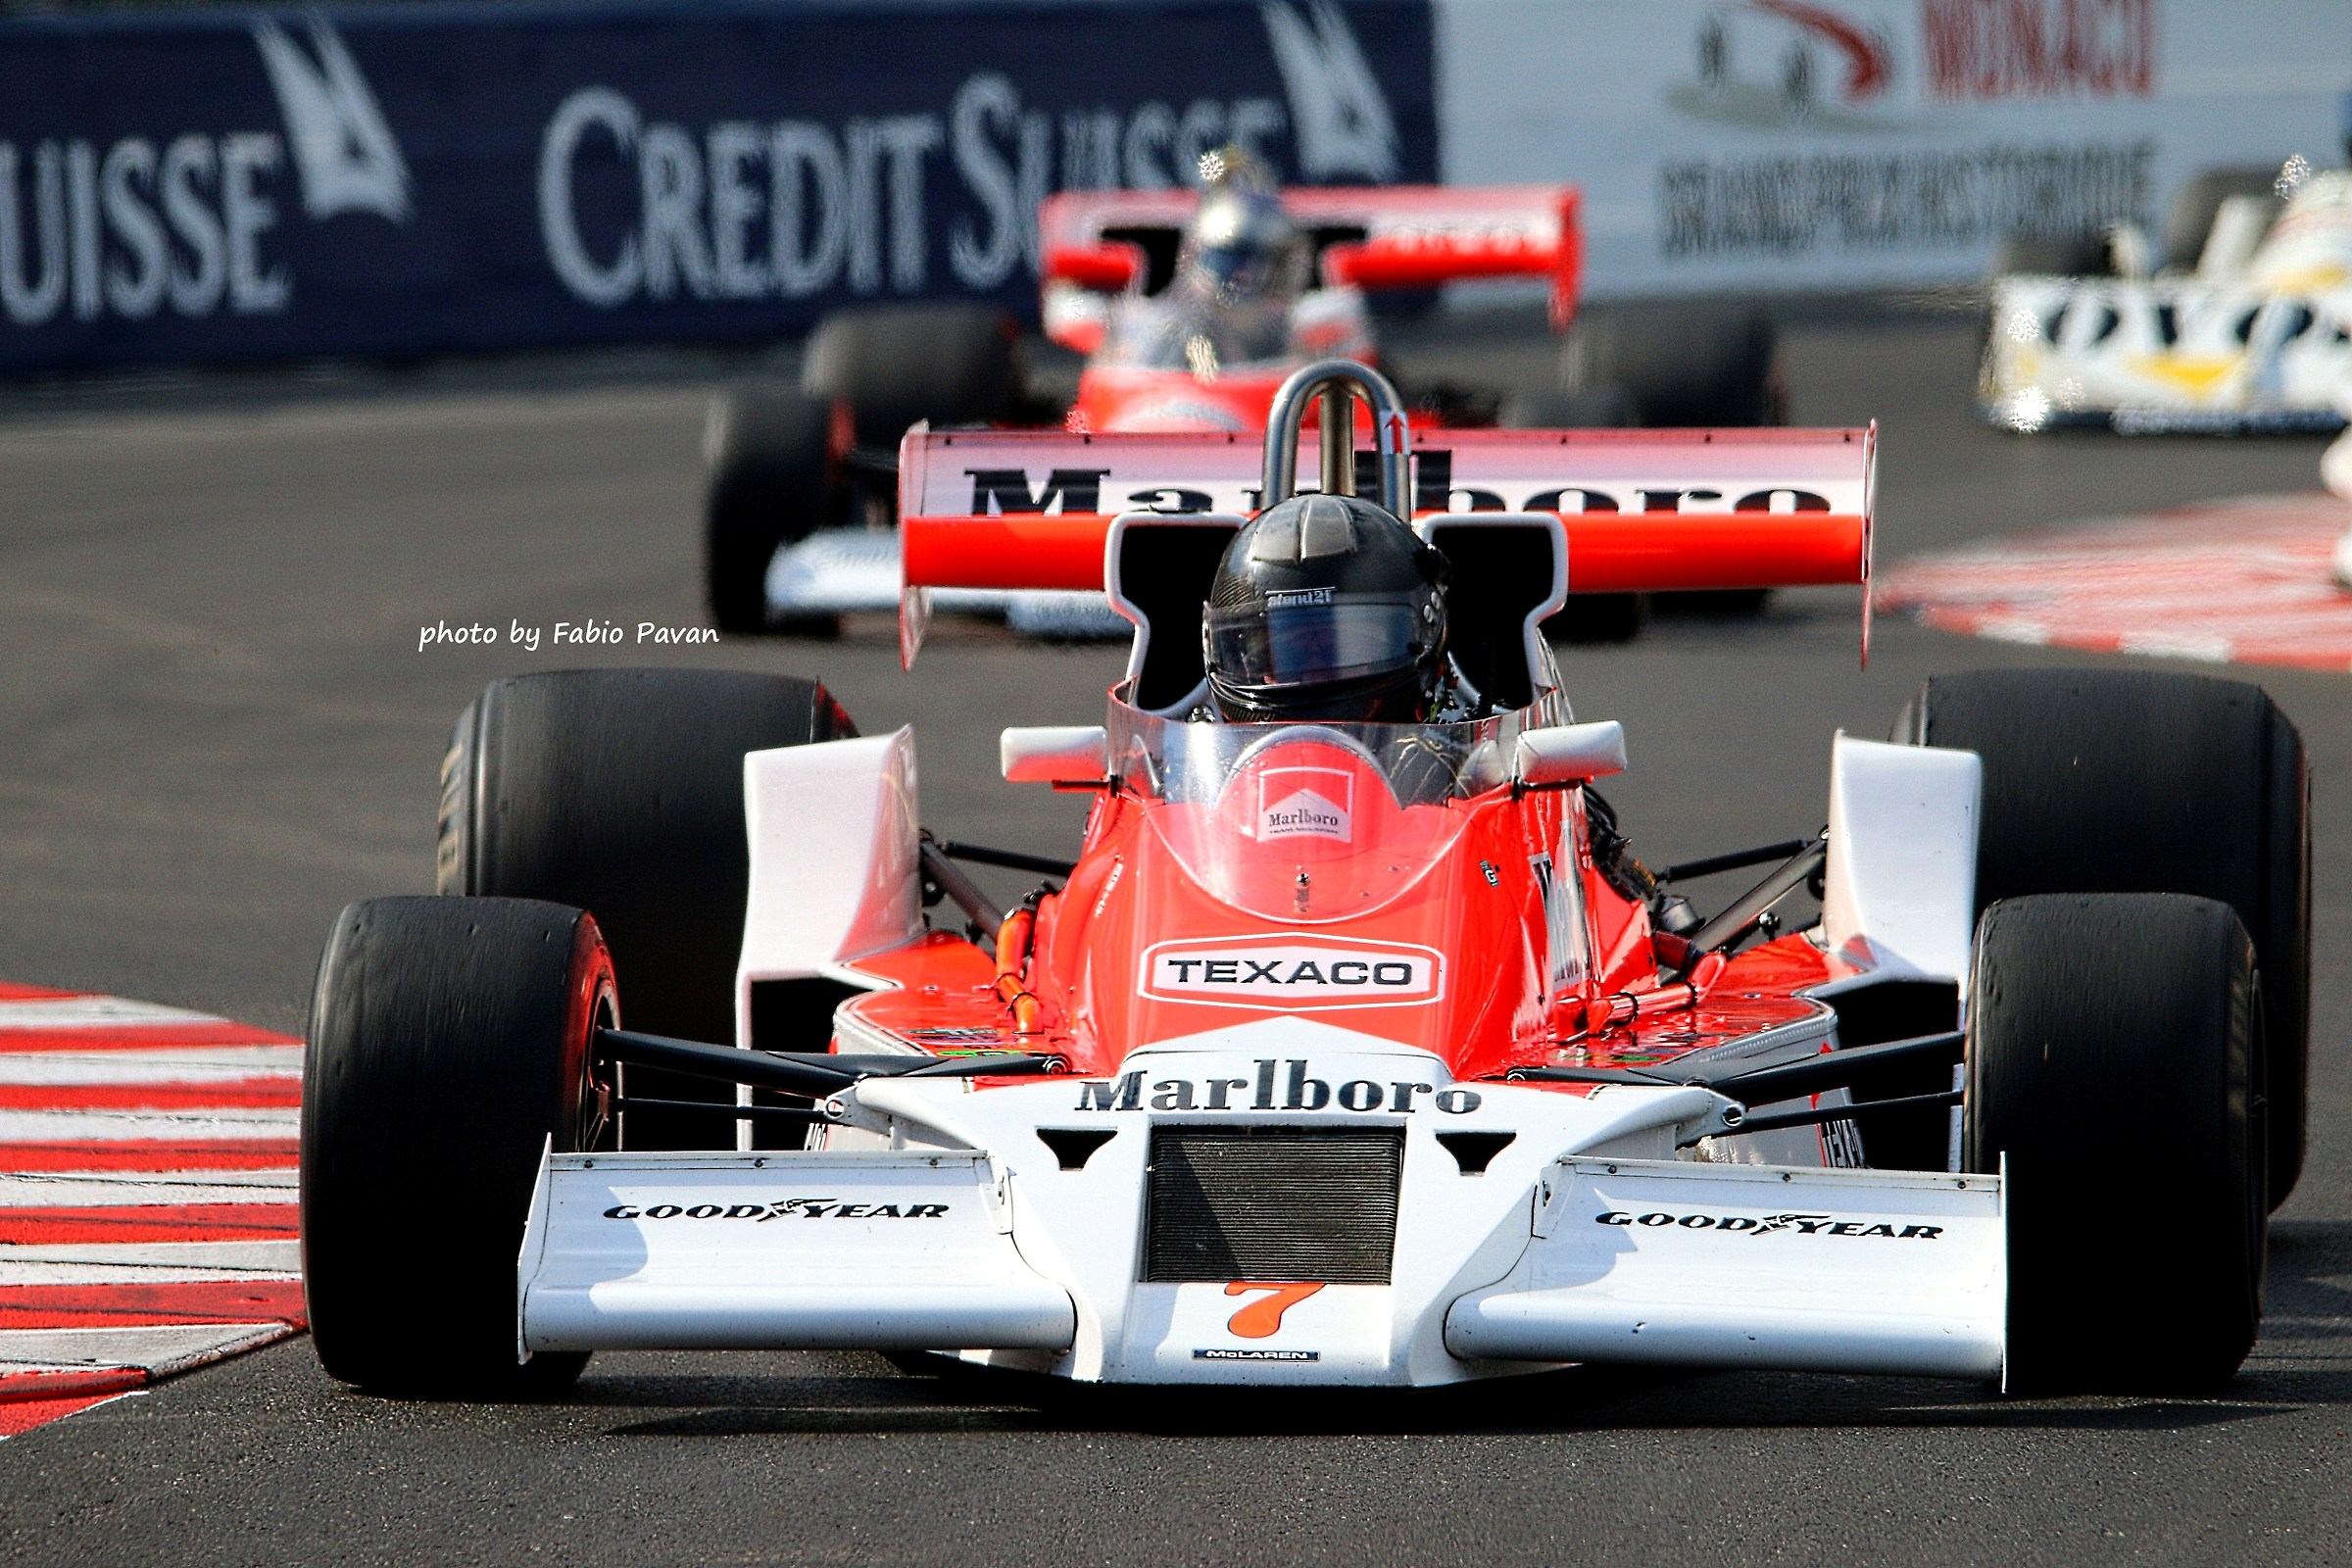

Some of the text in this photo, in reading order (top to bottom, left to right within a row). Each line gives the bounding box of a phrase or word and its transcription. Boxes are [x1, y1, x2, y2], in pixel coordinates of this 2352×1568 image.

[539, 85, 941, 307] CREDIT
[1269, 808, 1339, 826] Marlboro
[1168, 959, 1412, 986] TEXACO
[1074, 1058, 1483, 1114] Marlboro
[1224, 1280, 1326, 1339] 7
